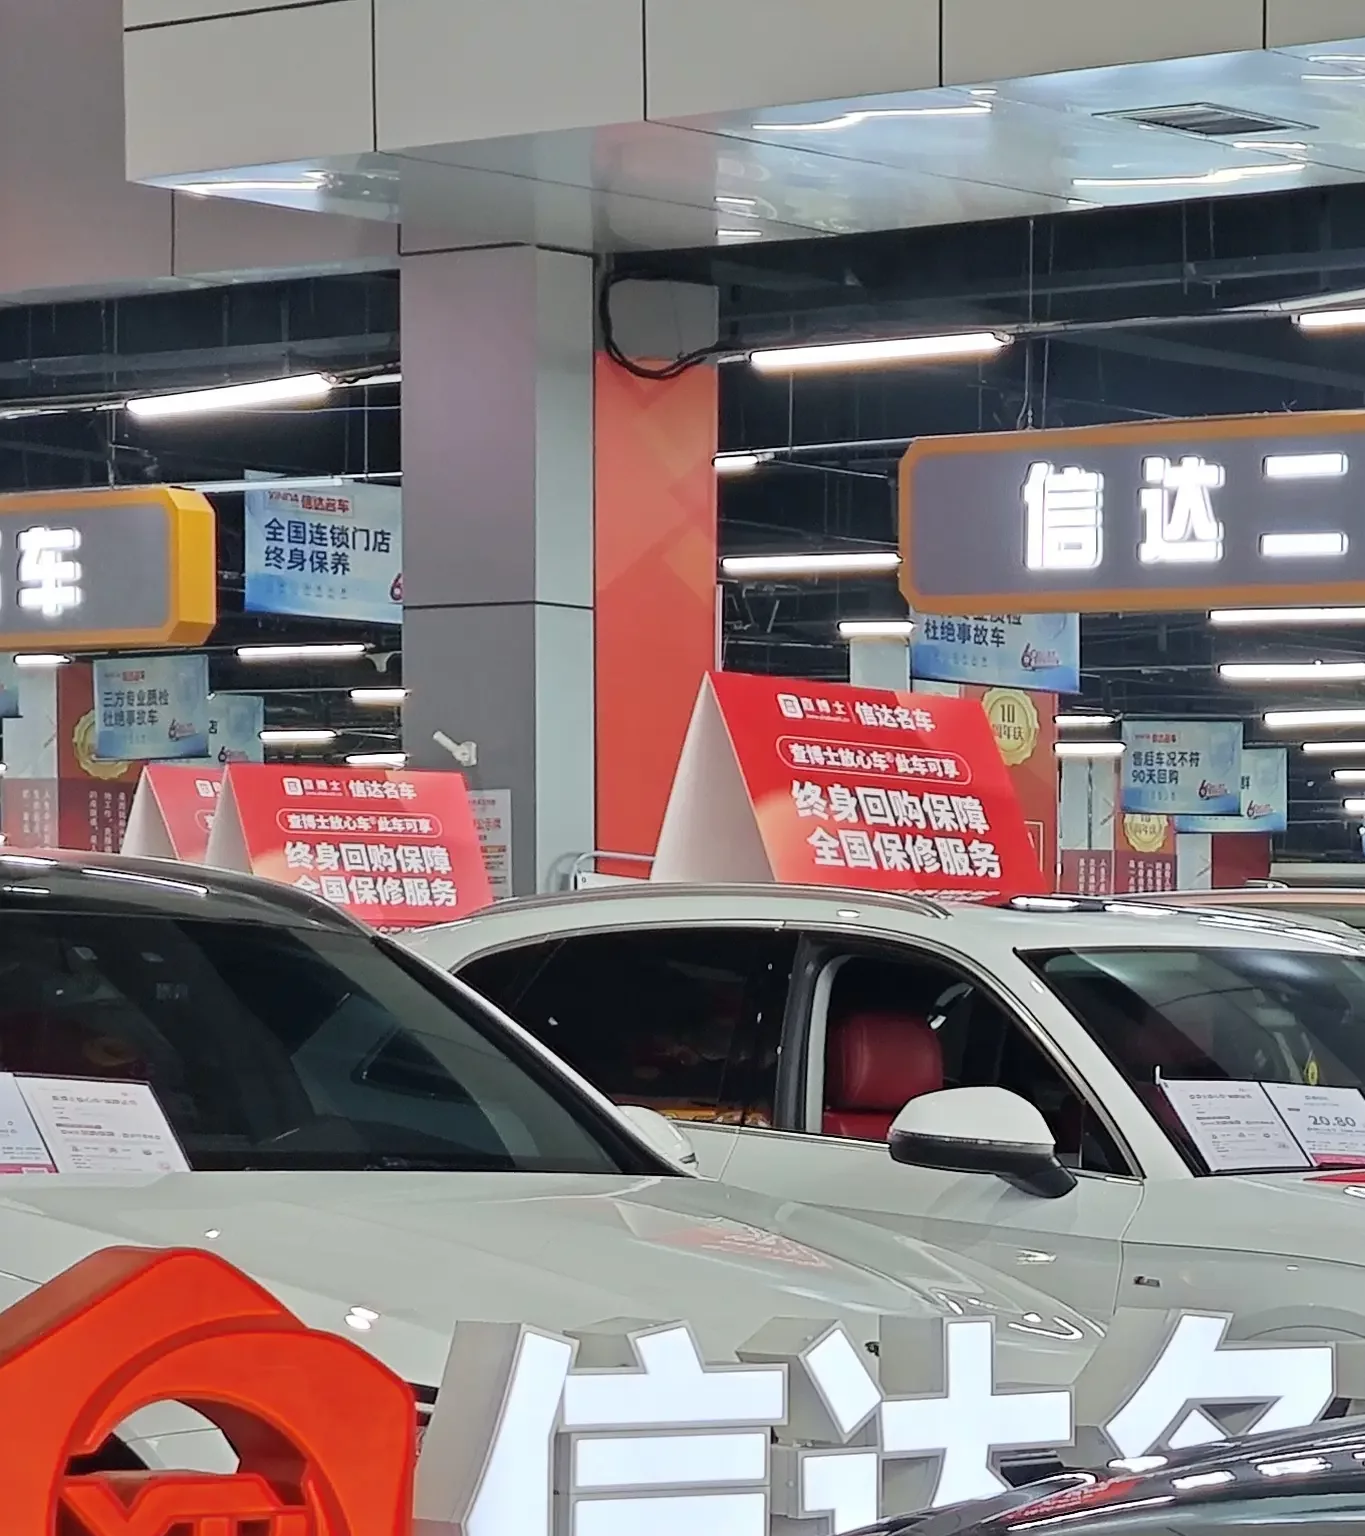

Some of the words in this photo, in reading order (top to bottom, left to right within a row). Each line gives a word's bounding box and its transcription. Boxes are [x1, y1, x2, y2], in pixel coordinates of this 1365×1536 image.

[301, 494, 350, 513] 信达名车
[264, 518, 392, 554] 全国连锁门店
[18, 527, 81, 617] 车
[264, 545, 351, 577] 终身保养
[924, 619, 1006, 648] 杜绝事故车
[855, 701, 936, 732] 信达名车
[1132, 752, 1200, 767] 售后车况不符
[348, 781, 416, 800] 信达名车
[1132, 769, 1179, 785] 90天回购
[791, 780, 991, 835] 终身回购保障
[284, 841, 453, 875] 终身回购保障
[806, 826, 1002, 878] 全国保修服务
[299, 875, 457, 907] 全国保修服务
